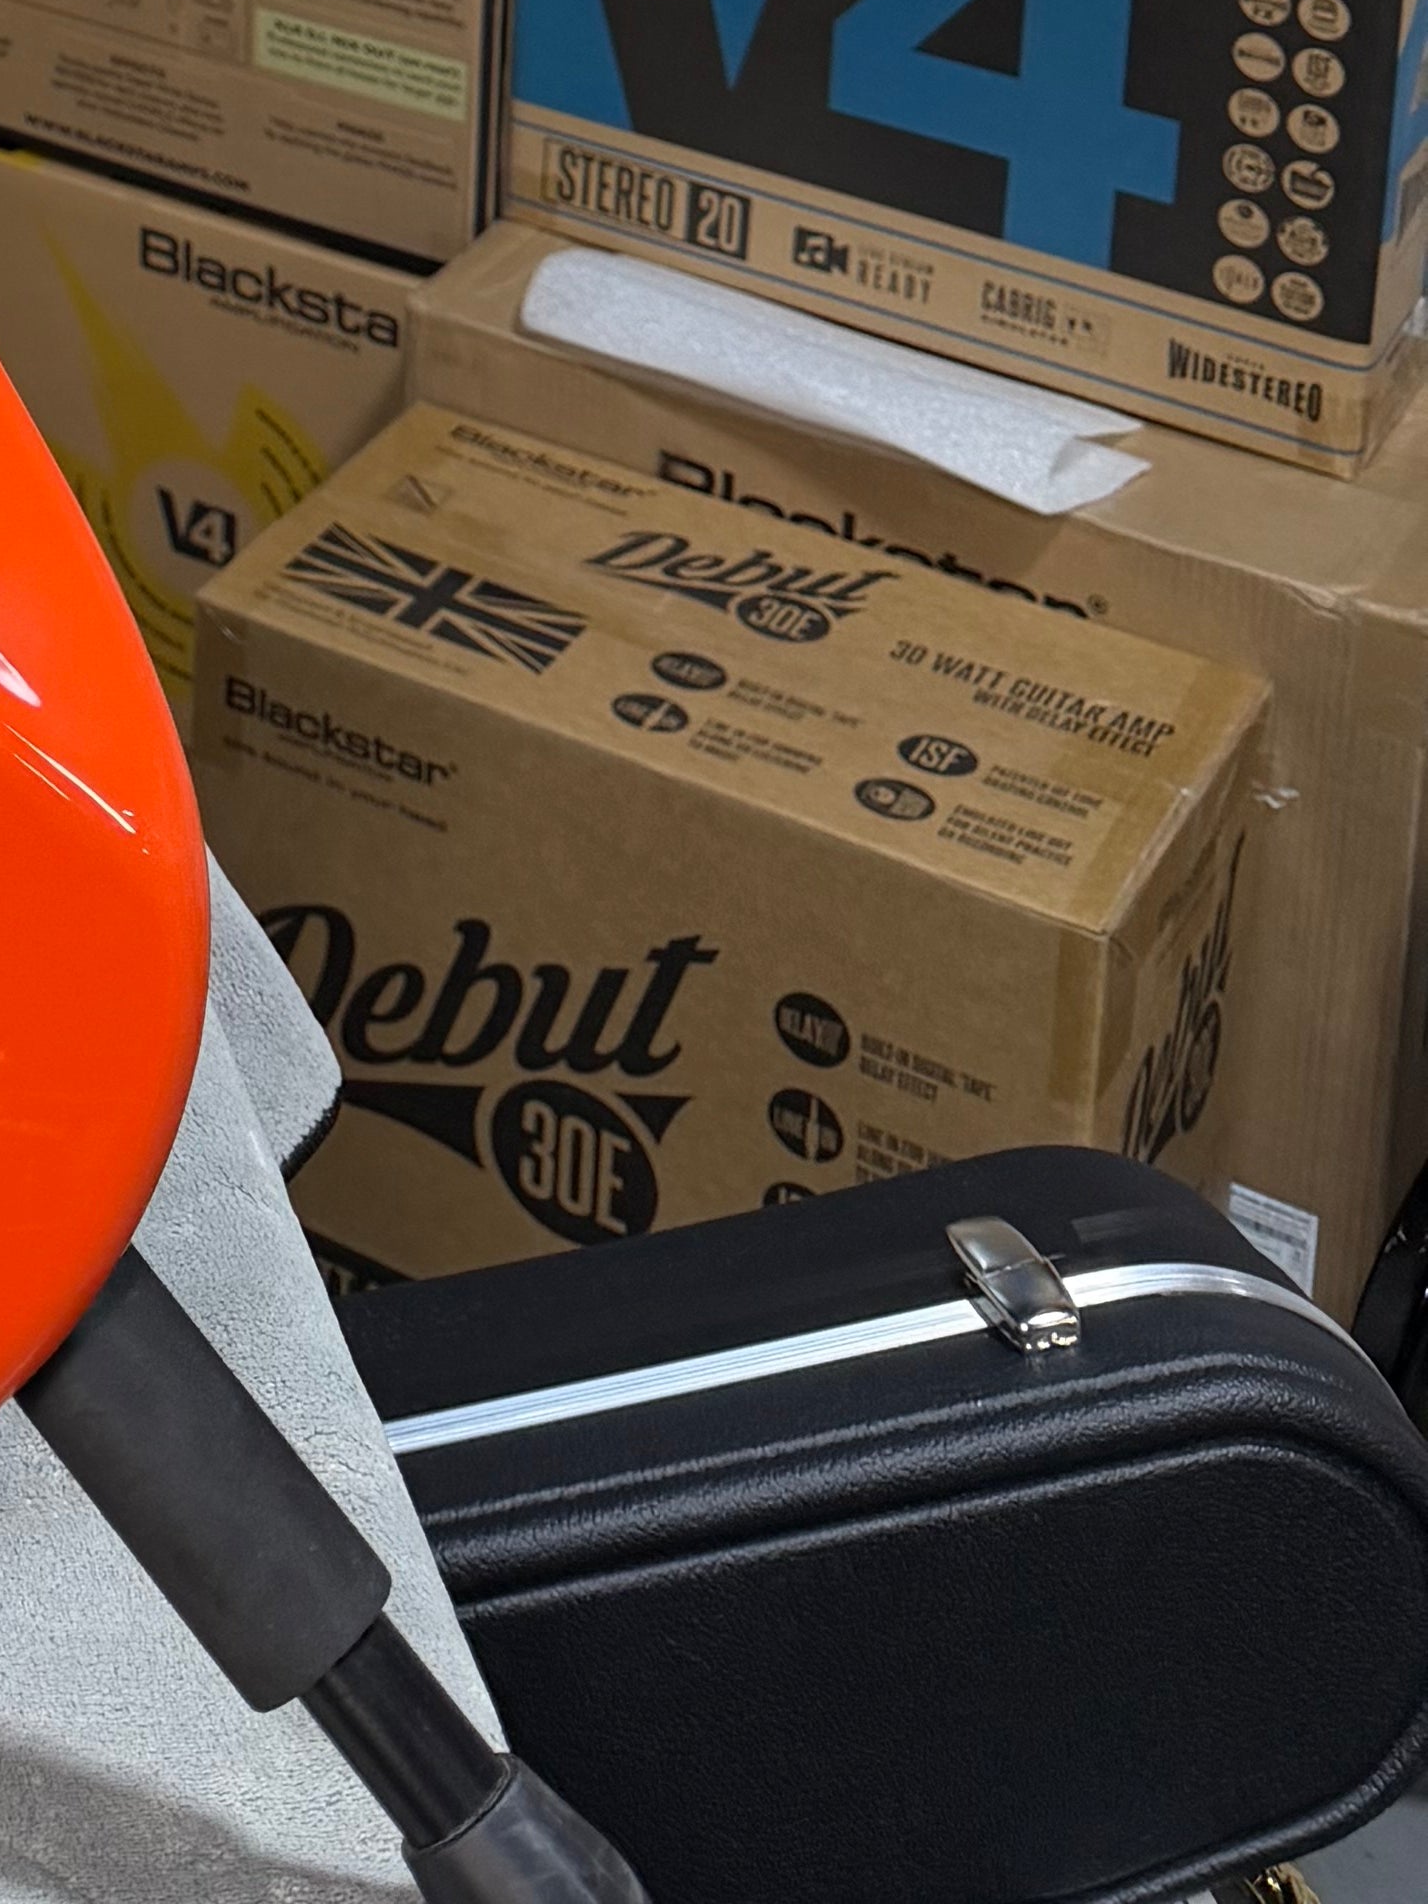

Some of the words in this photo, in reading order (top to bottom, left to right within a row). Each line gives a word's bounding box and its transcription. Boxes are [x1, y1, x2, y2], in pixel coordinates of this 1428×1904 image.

[555, 148, 676, 233] STEREO
[695, 188, 744, 256] 20
[856, 259, 932, 305] READY
[1167, 336, 1324, 423] WIDESTEREO
[583, 528, 902, 603] Debut
[749, 595, 816, 641] 30E
[224, 672, 452, 786] Blackstar
[889, 639, 929, 667] 30
[931, 650, 1006, 690] WATT
[1008, 676, 1109, 724] GUITAR
[1108, 710, 1176, 742] AMP
[908, 736, 969, 772] ISF
[257, 902, 720, 1079] Debut
[518, 1098, 634, 1237] 30E
